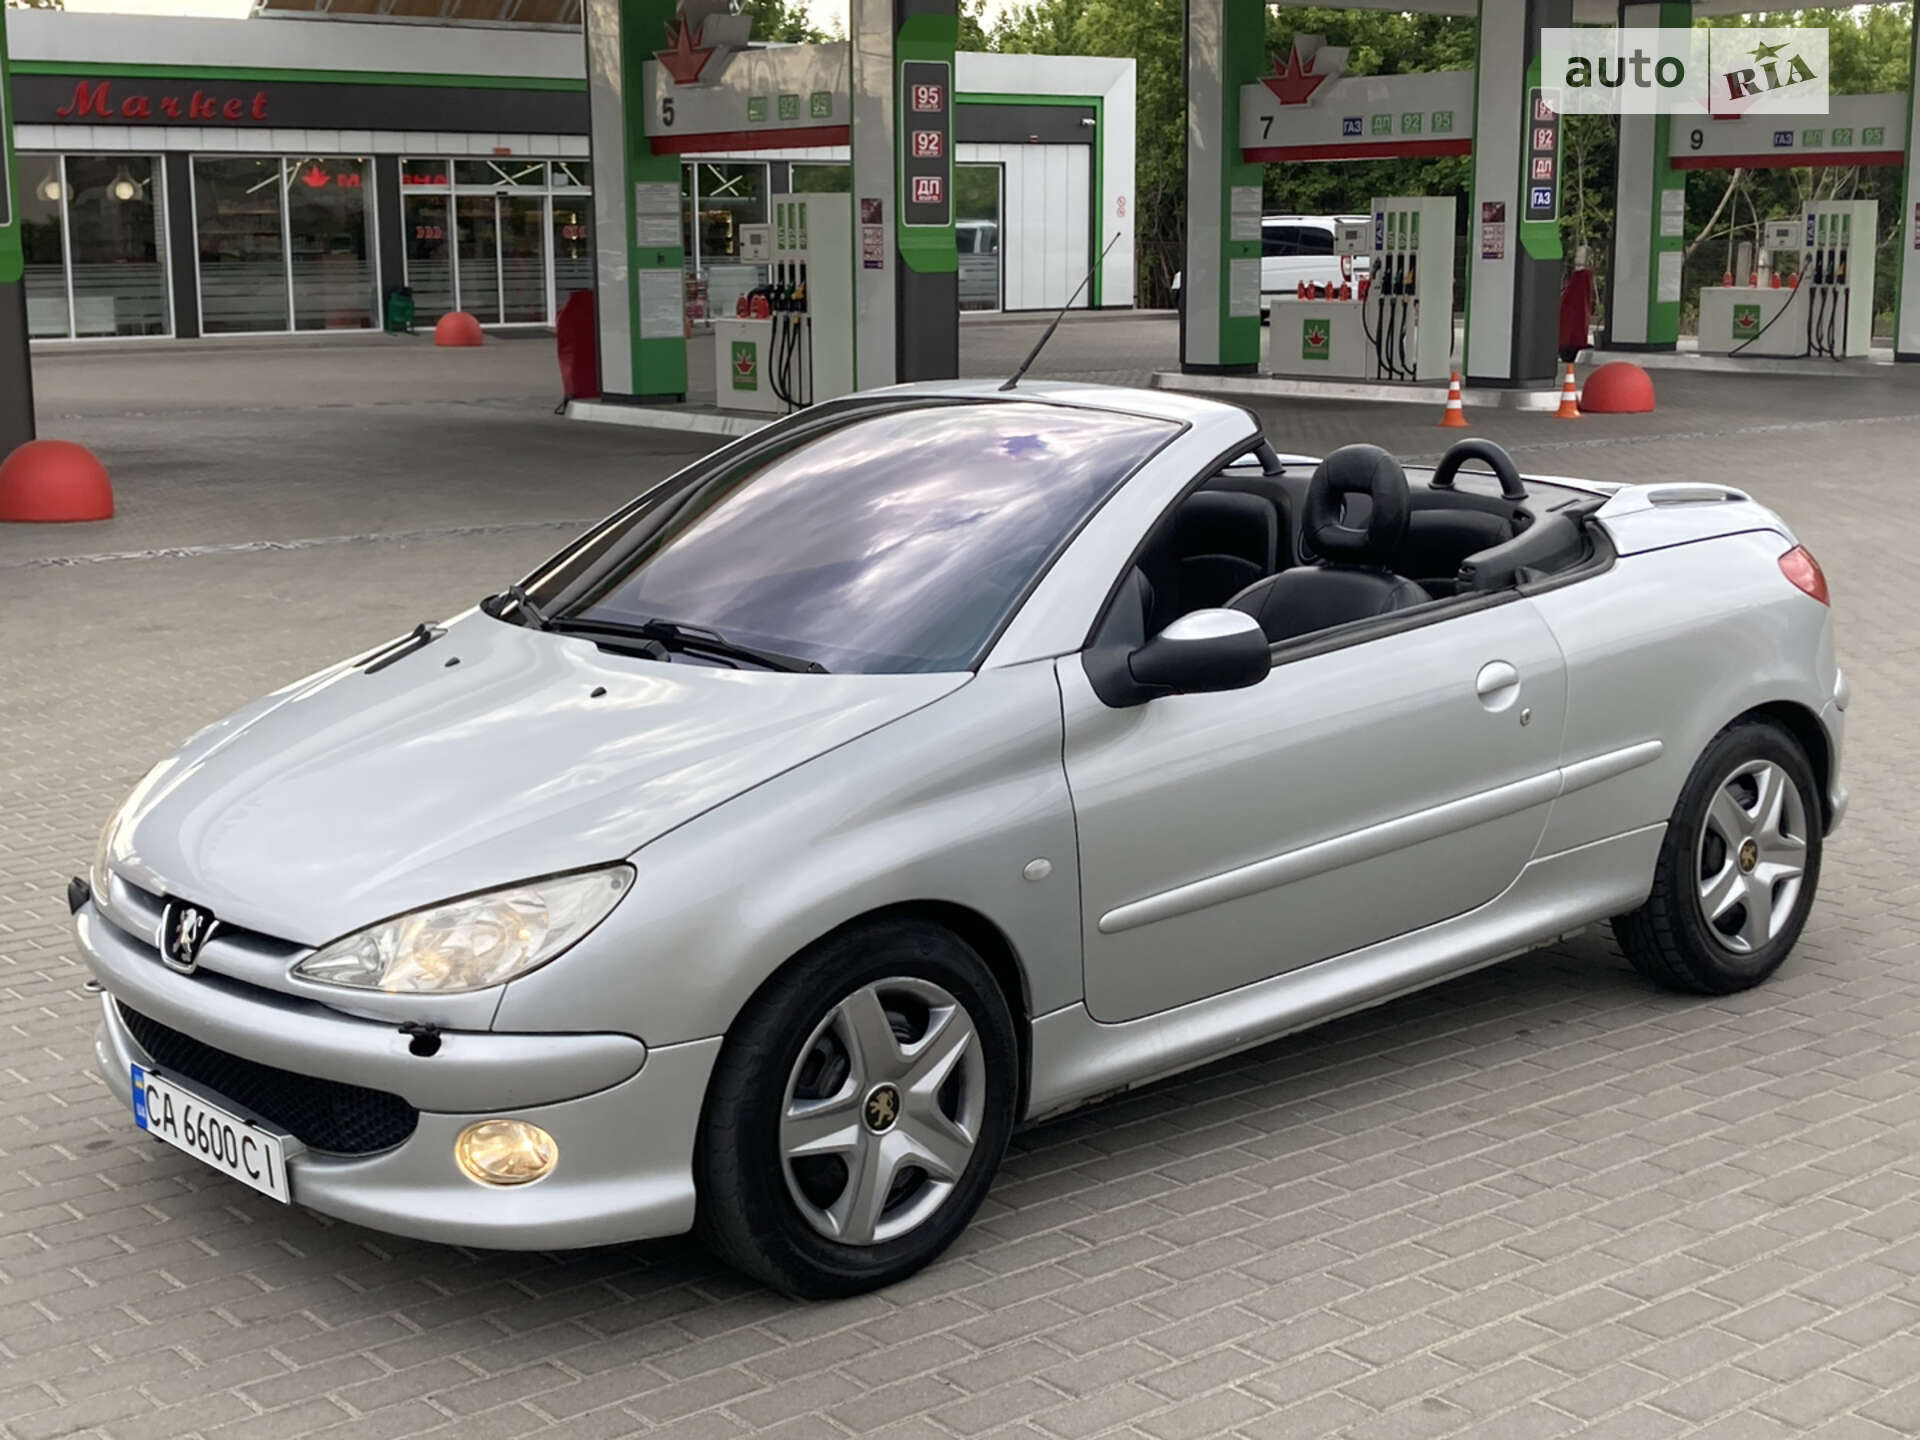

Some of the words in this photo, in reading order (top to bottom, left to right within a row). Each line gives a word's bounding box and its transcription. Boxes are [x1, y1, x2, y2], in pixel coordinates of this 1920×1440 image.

[56, 80, 268, 121] Market
[918, 87, 939, 104] 95
[662, 98, 675, 126] 5
[1260, 116, 1274, 139] 7
[1343, 121, 1361, 134] ГАЗ
[1403, 114, 1419, 128] 92
[1434, 113, 1450, 127] 95
[918, 133, 939, 150] 92
[1538, 129, 1553, 144] 92
[1690, 129, 1704, 150] 9
[1775, 133, 1793, 145] ГАЗ
[1536, 160, 1552, 173] ДП
[917, 180, 940, 195] ДП
[1534, 192, 1551, 205] ГАЗ
[146, 1084, 178, 1138] CA
[184, 1104, 238, 1169] 6600
[241, 1135, 275, 1189] CI
